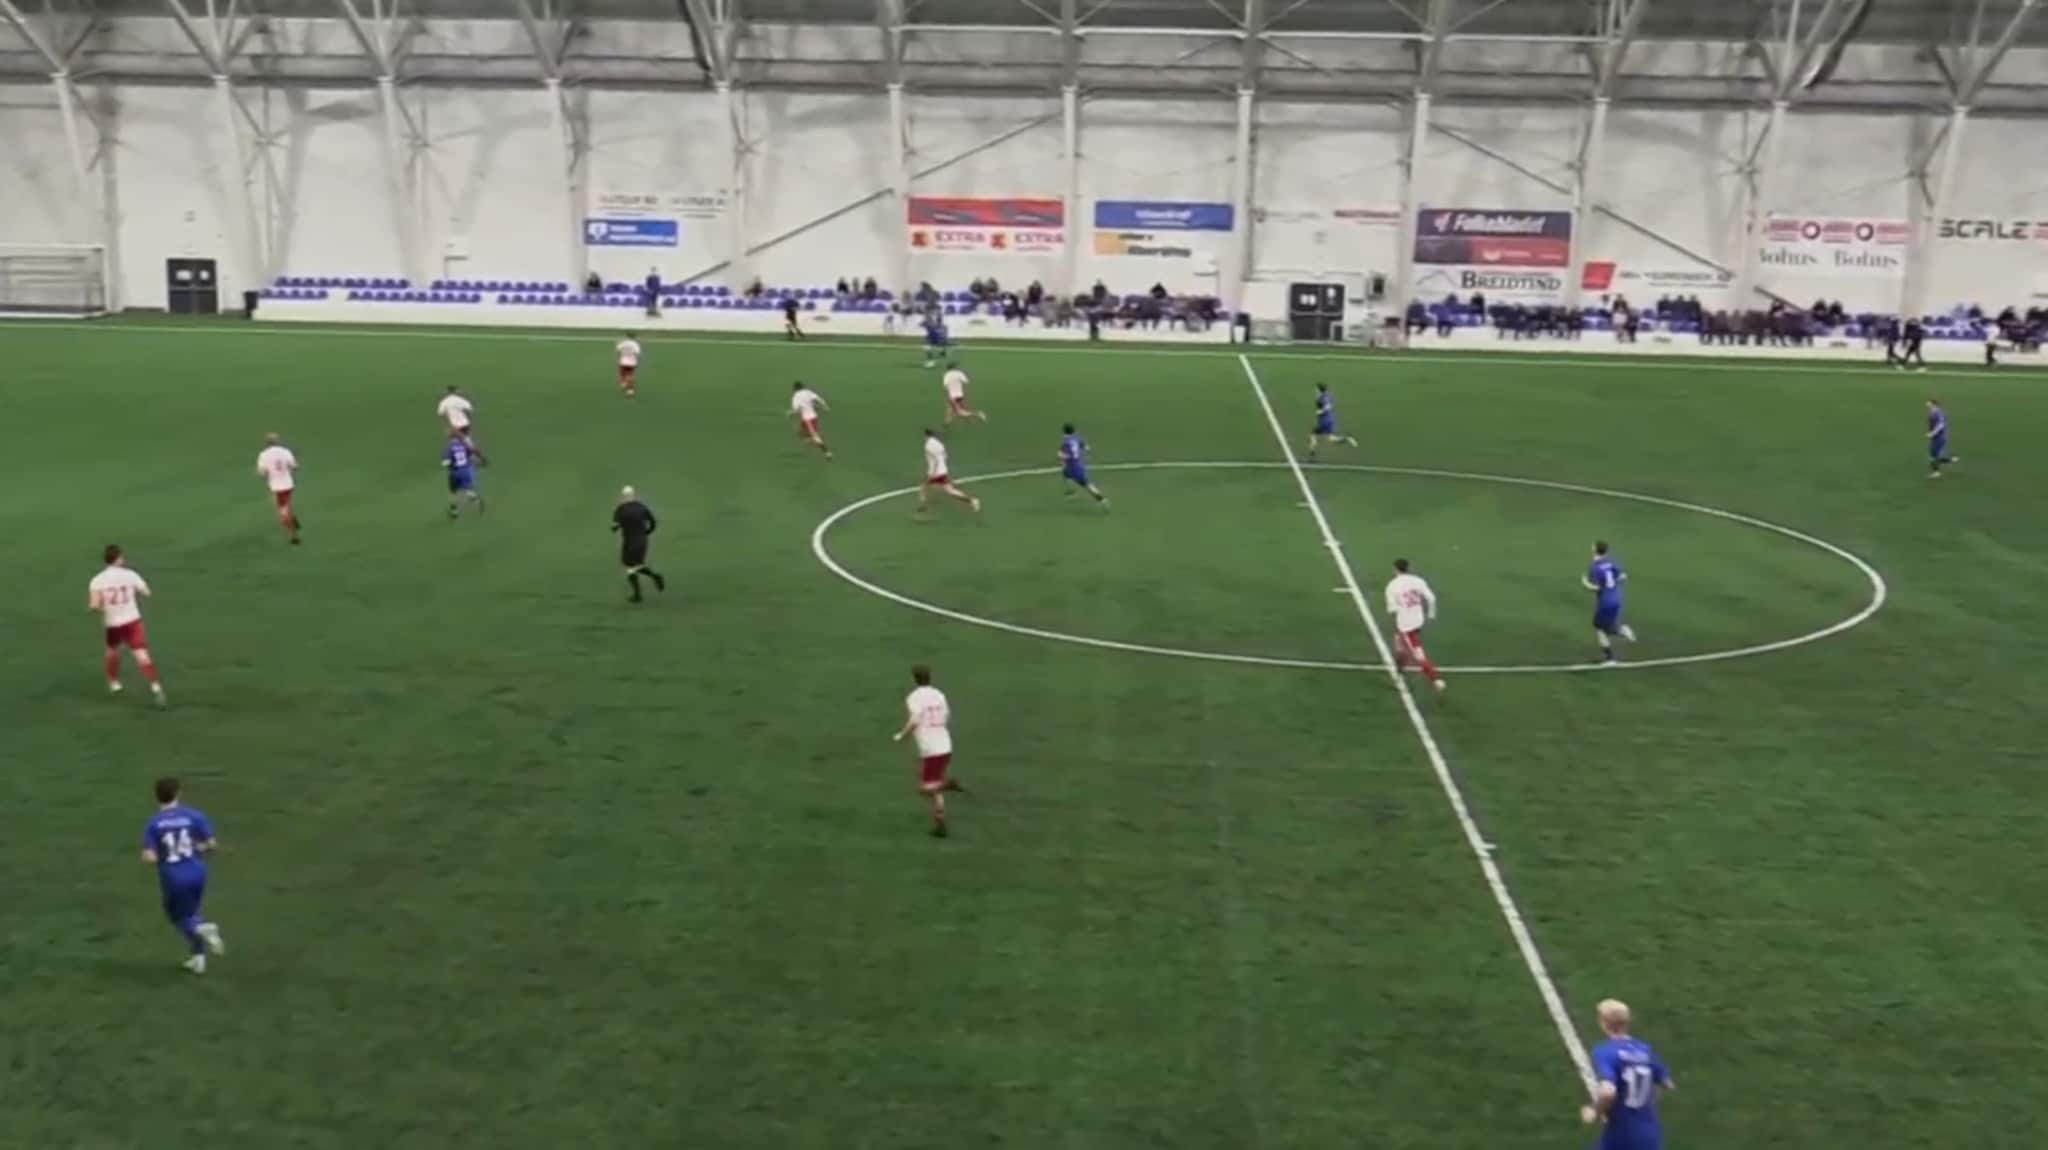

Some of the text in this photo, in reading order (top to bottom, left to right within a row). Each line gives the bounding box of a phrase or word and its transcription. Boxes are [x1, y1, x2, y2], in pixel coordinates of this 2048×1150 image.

[935, 231, 1065, 244] EXTRA EXTRA
[1938, 219, 2029, 240] SCALE
[161, 829, 193, 863] 14
[1621, 1065, 1652, 1109] 17
